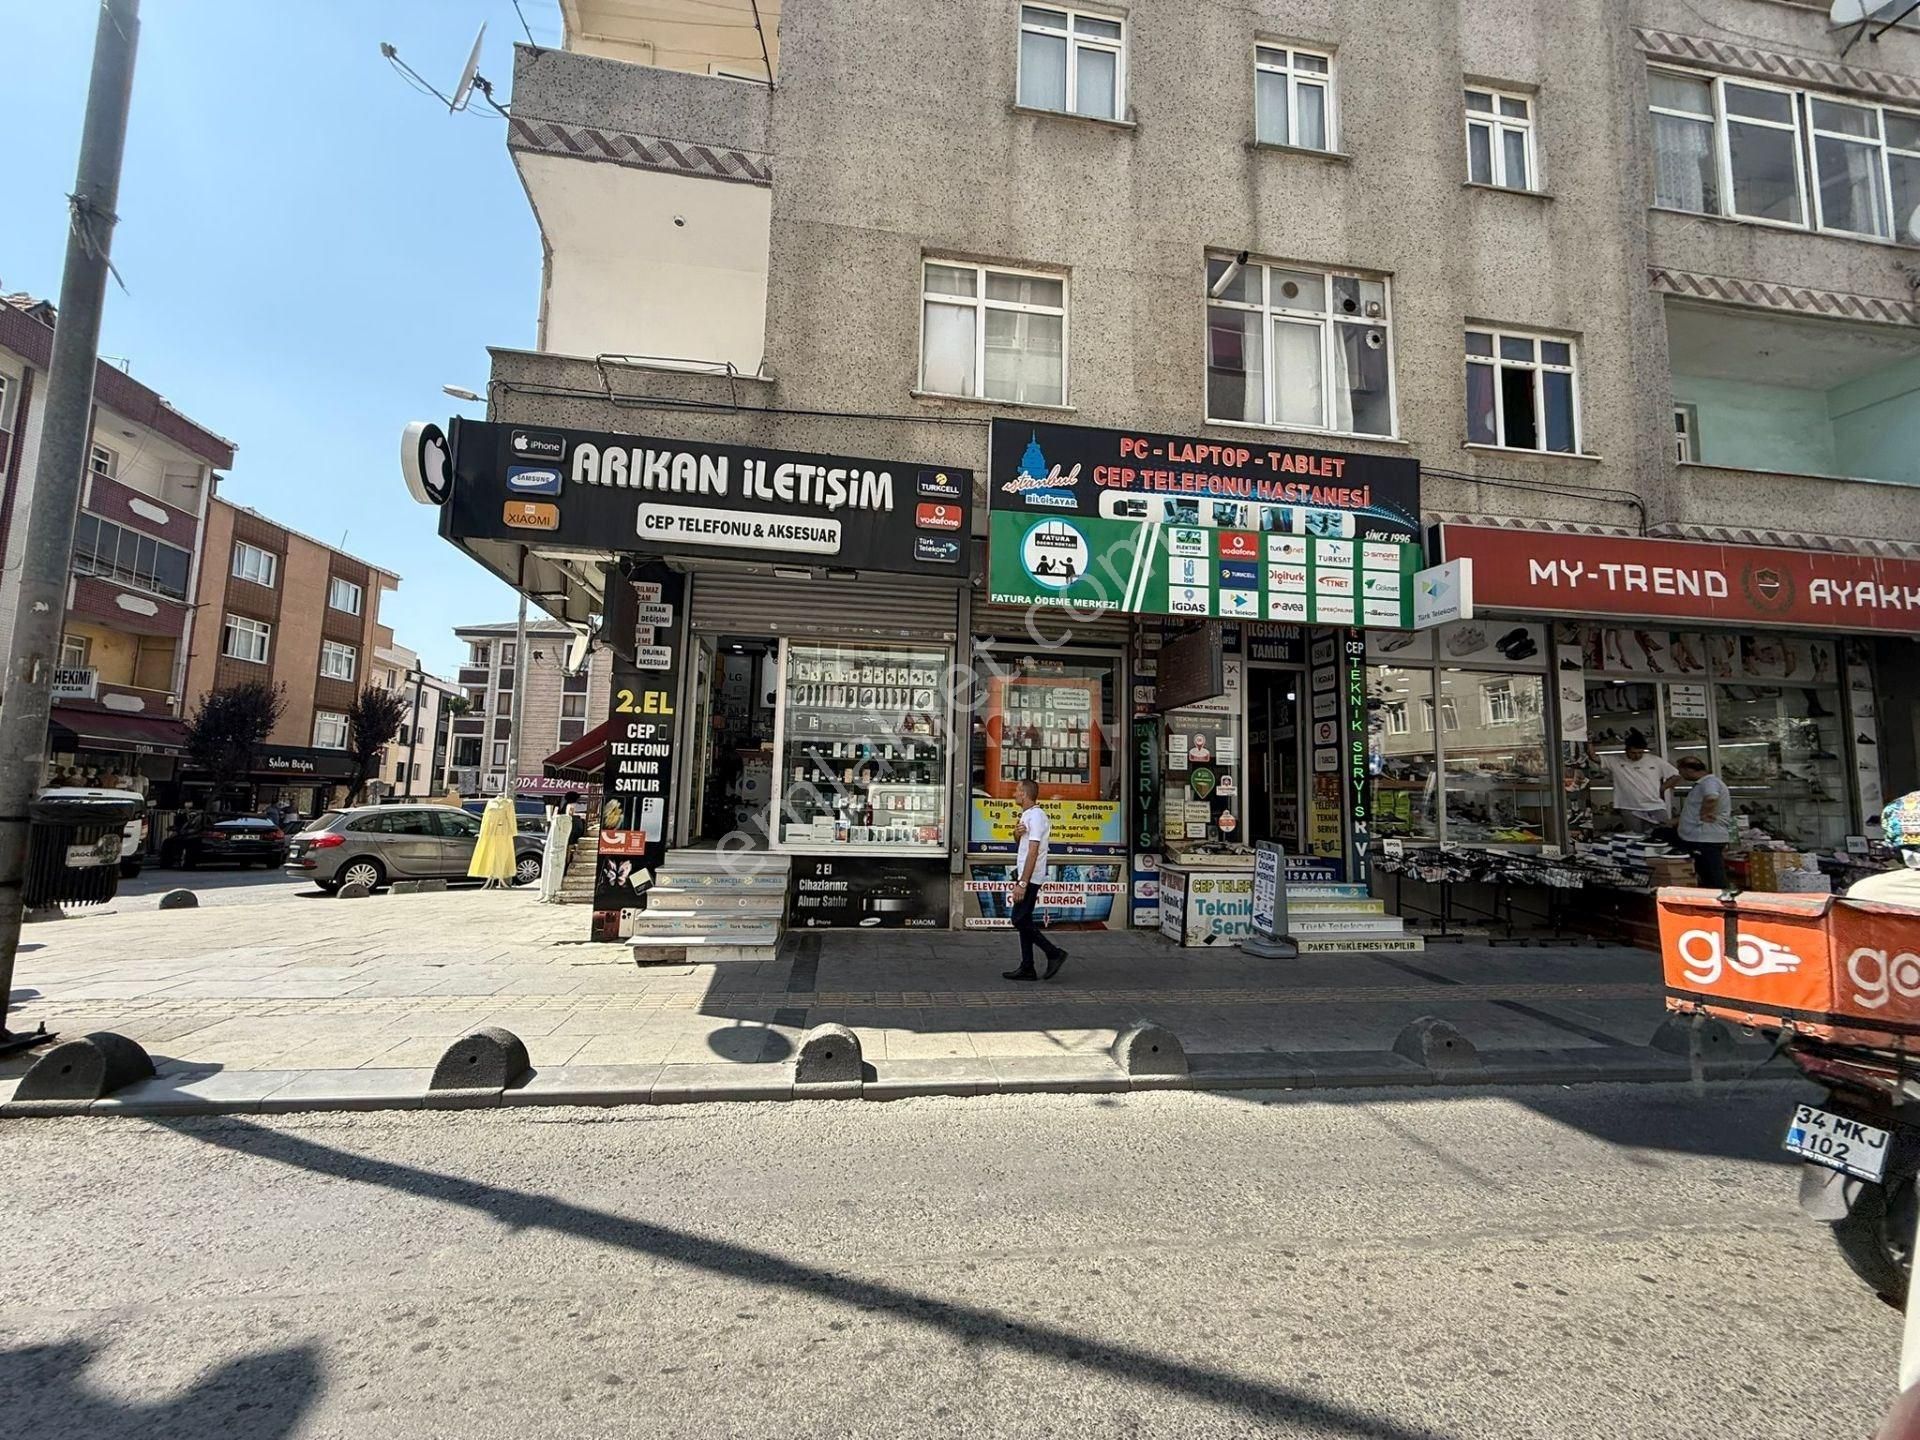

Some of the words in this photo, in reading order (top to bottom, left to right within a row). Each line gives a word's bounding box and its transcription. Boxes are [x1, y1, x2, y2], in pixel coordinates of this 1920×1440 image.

[530, 442, 560, 451] iPhone
[1120, 437, 1148, 459] PC
[1168, 443, 1250, 468] LAPTOP
[1268, 452, 1345, 478] TABLET
[572, 443, 729, 497] ARIKAN
[516, 474, 550, 483] SAMSUNG
[921, 483, 960, 493] TURKCELL
[1093, 466, 1136, 489] CEP
[1140, 470, 1252, 498] TELEFONU
[1257, 480, 1371, 508] HASTANESİ
[1026, 494, 1076, 506] BİLGİSAYAR
[508, 514, 551, 527] XIAOMI
[920, 516, 959, 527] vodafone
[645, 515, 674, 530] CEP
[678, 517, 751, 538] TELEFONU
[755, 523, 764, 538] &
[767, 524, 836, 543] AKSESUAR
[1041, 534, 1071, 543] FATURA
[1391, 534, 1411, 544] 1996
[918, 545, 947, 553] Telekom
[1221, 547, 1256, 556] vodafone
[1232, 571, 1256, 579] TURKCELL
[1528, 558, 1729, 598] MY-TREND
[1325, 579, 1349, 588] TTNET
[991, 593, 1031, 604] FATURA
[1034, 594, 1071, 607] ÖDEME
[1073, 598, 1119, 610] MERKEZİ
[1281, 602, 1304, 612] avea
[645, 605, 667, 613] EKRAN
[1432, 605, 1458, 617] Telekom
[1252, 642, 1289, 659] TAMİRİ
[1345, 642, 1364, 654] CEP
[54, 670, 91, 685] HEKİMİ
[729, 672, 743, 682] LG
[616, 689, 674, 715] 2.EL
[627, 723, 655, 739] CEP
[611, 743, 670, 757] TELEFONU
[619, 761, 659, 774] ALINIR
[615, 779, 660, 792] SATILIR
[983, 800, 1014, 810] Philips
[1076, 803, 1114, 811] Siemens
[990, 811, 1001, 819] Lg
[1071, 812, 1103, 821] Arçelik
[816, 865, 822, 875] 2
[824, 864, 832, 875] El
[799, 879, 848, 892] Cihazlarınız
[1193, 880, 1215, 893] CEP
[1217, 880, 1254, 894] TELEF
[798, 895, 820, 907] Alınır
[822, 896, 848, 907] Satılır
[1043, 896, 1086, 905] BURADA.
[1307, 943, 1334, 951] PAKET
[1384, 942, 1416, 951] YAPILIR
[1847, 948, 1920, 1009] go
[1797, 1107, 1827, 1130] 34
[1833, 1118, 1887, 1149] MKJ
[1810, 1133, 1850, 1162] 102
